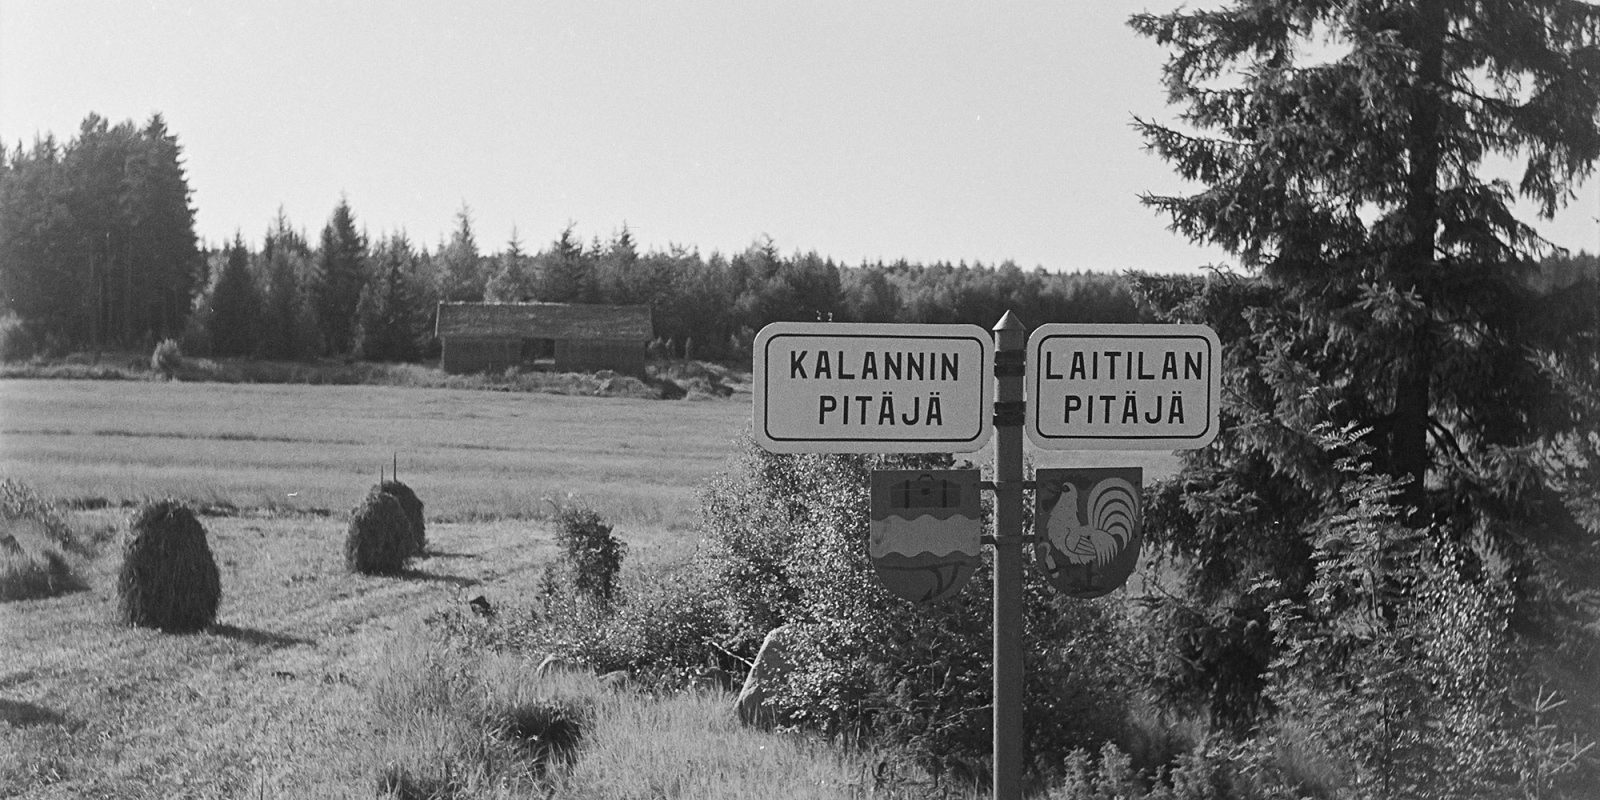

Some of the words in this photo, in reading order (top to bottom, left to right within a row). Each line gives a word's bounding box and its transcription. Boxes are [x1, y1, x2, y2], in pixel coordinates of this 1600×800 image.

[790, 350, 960, 382] KALANNIN
[1045, 350, 1203, 381] LAITILAN
[818, 391, 943, 426] PITÄJÄ
[1063, 391, 1185, 425] PITÄJÄ
